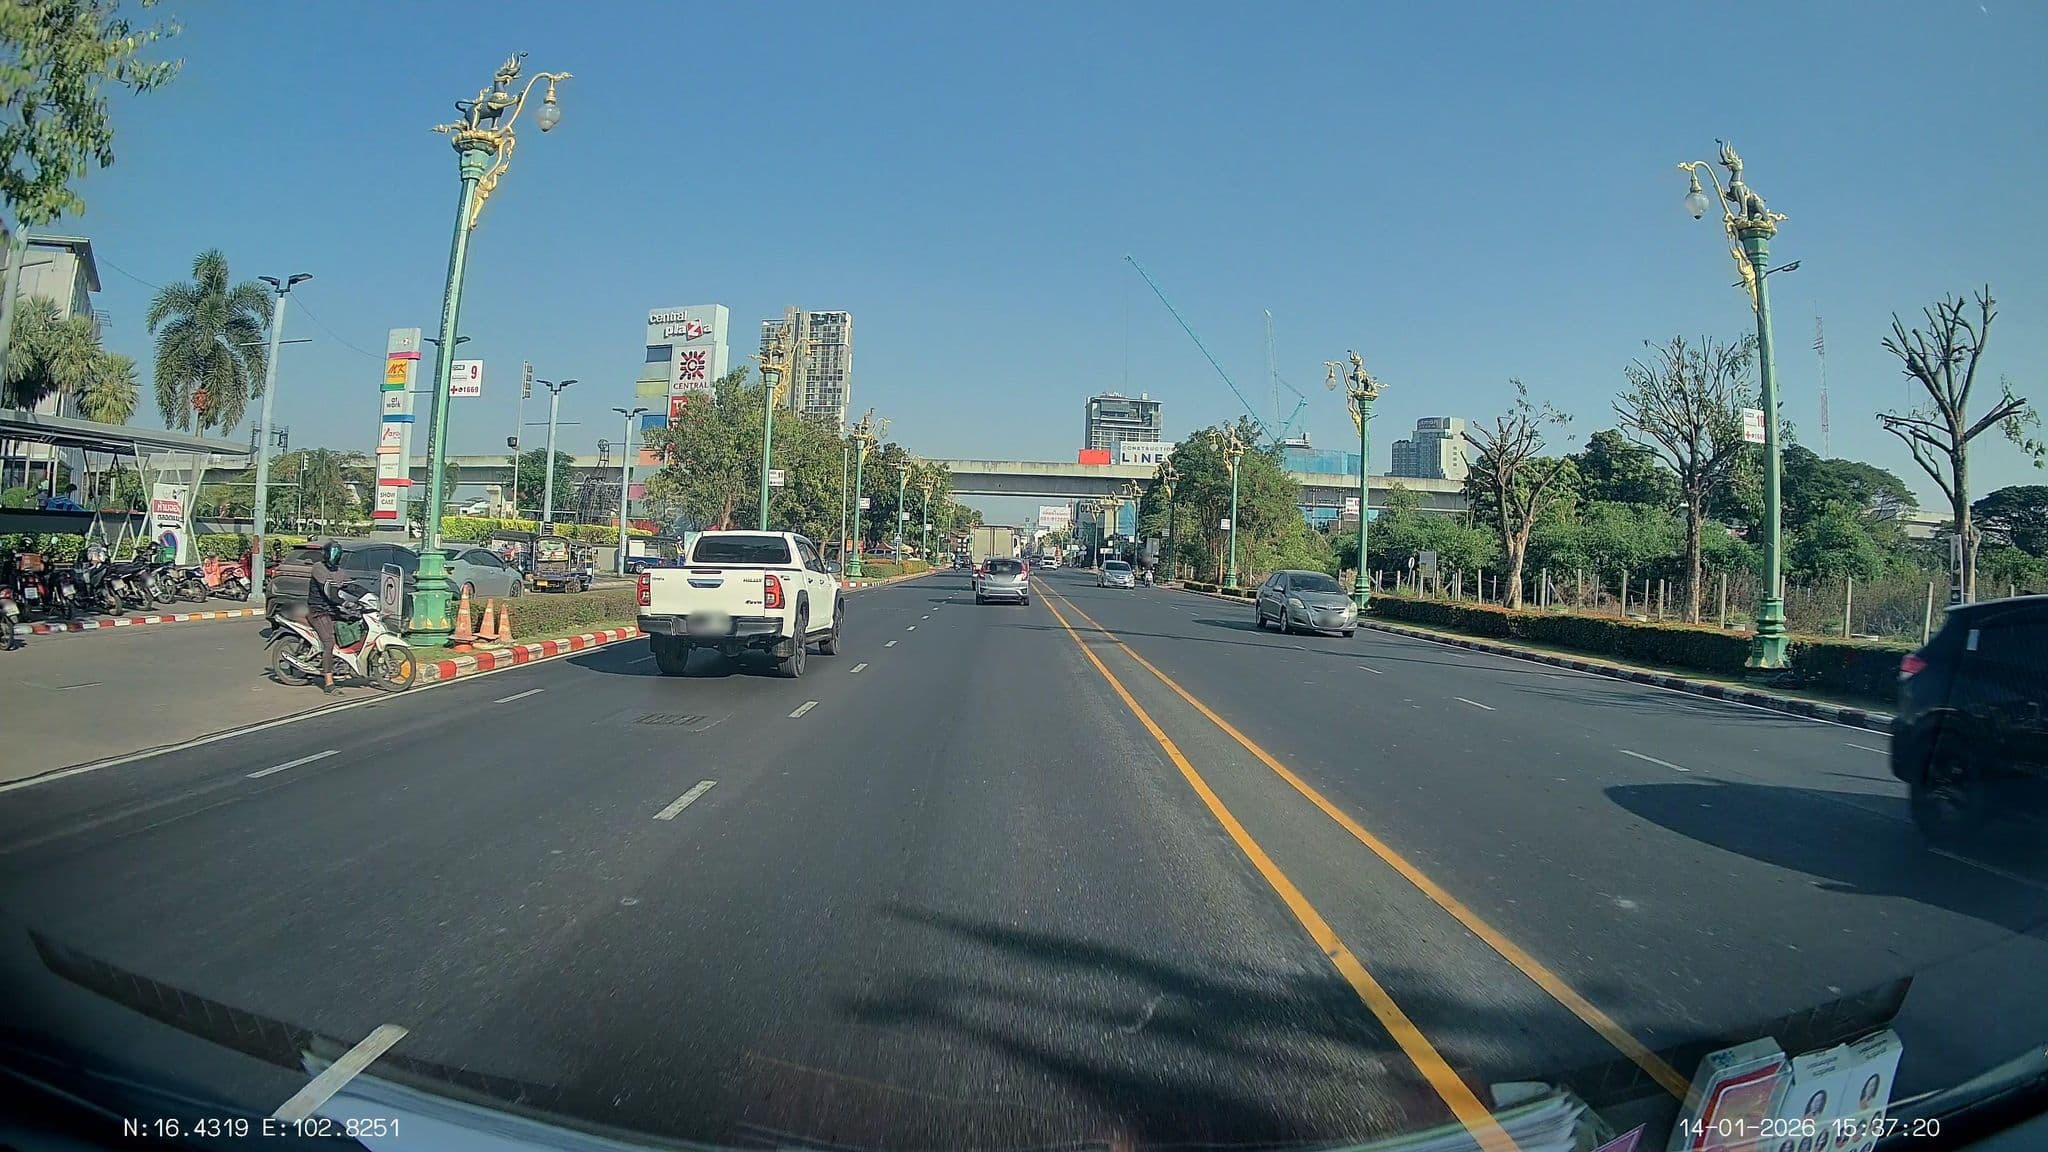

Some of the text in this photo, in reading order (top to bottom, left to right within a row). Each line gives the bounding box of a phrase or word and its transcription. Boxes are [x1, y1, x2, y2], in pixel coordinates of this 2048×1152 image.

[649, 310, 688, 325] central
[471, 365, 478, 379] 9
[673, 381, 709, 390] CENTRAL
[1122, 453, 1163, 464] LINE
